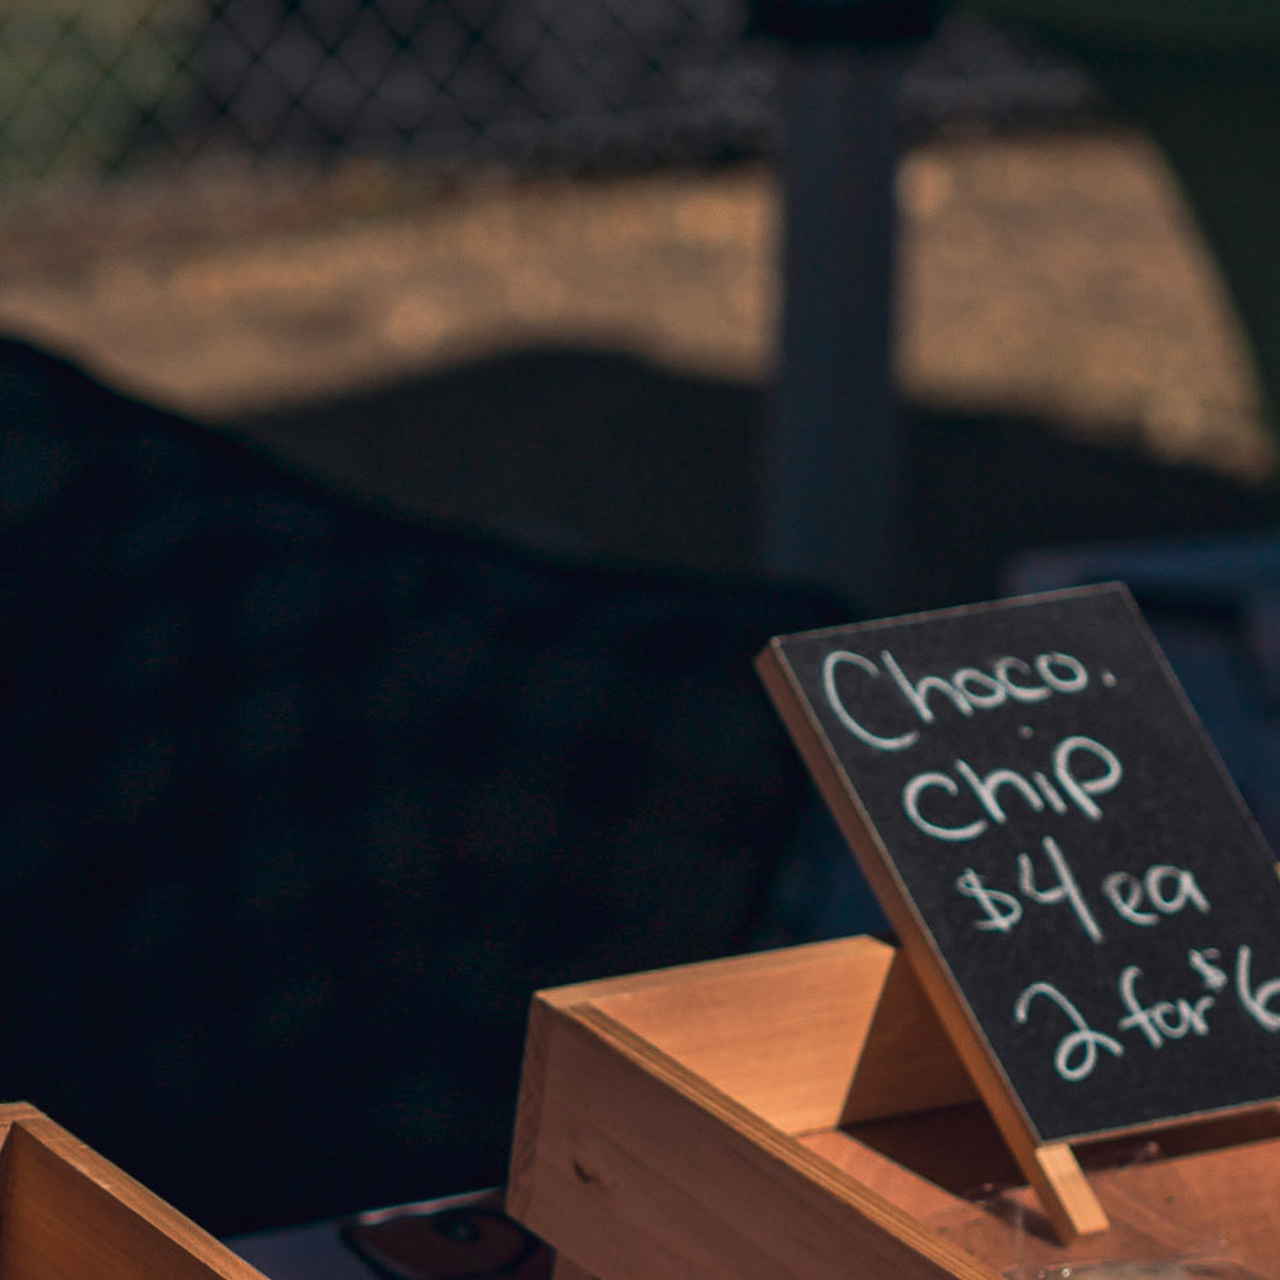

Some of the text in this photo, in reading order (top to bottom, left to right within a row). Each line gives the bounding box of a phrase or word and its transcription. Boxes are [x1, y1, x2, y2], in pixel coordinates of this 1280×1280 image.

[823, 650, 1117, 751] Choco.
[956, 835, 1210, 945] $4 ea
[1014, 980, 1124, 1082] 2
[1119, 965, 1217, 1049] for
